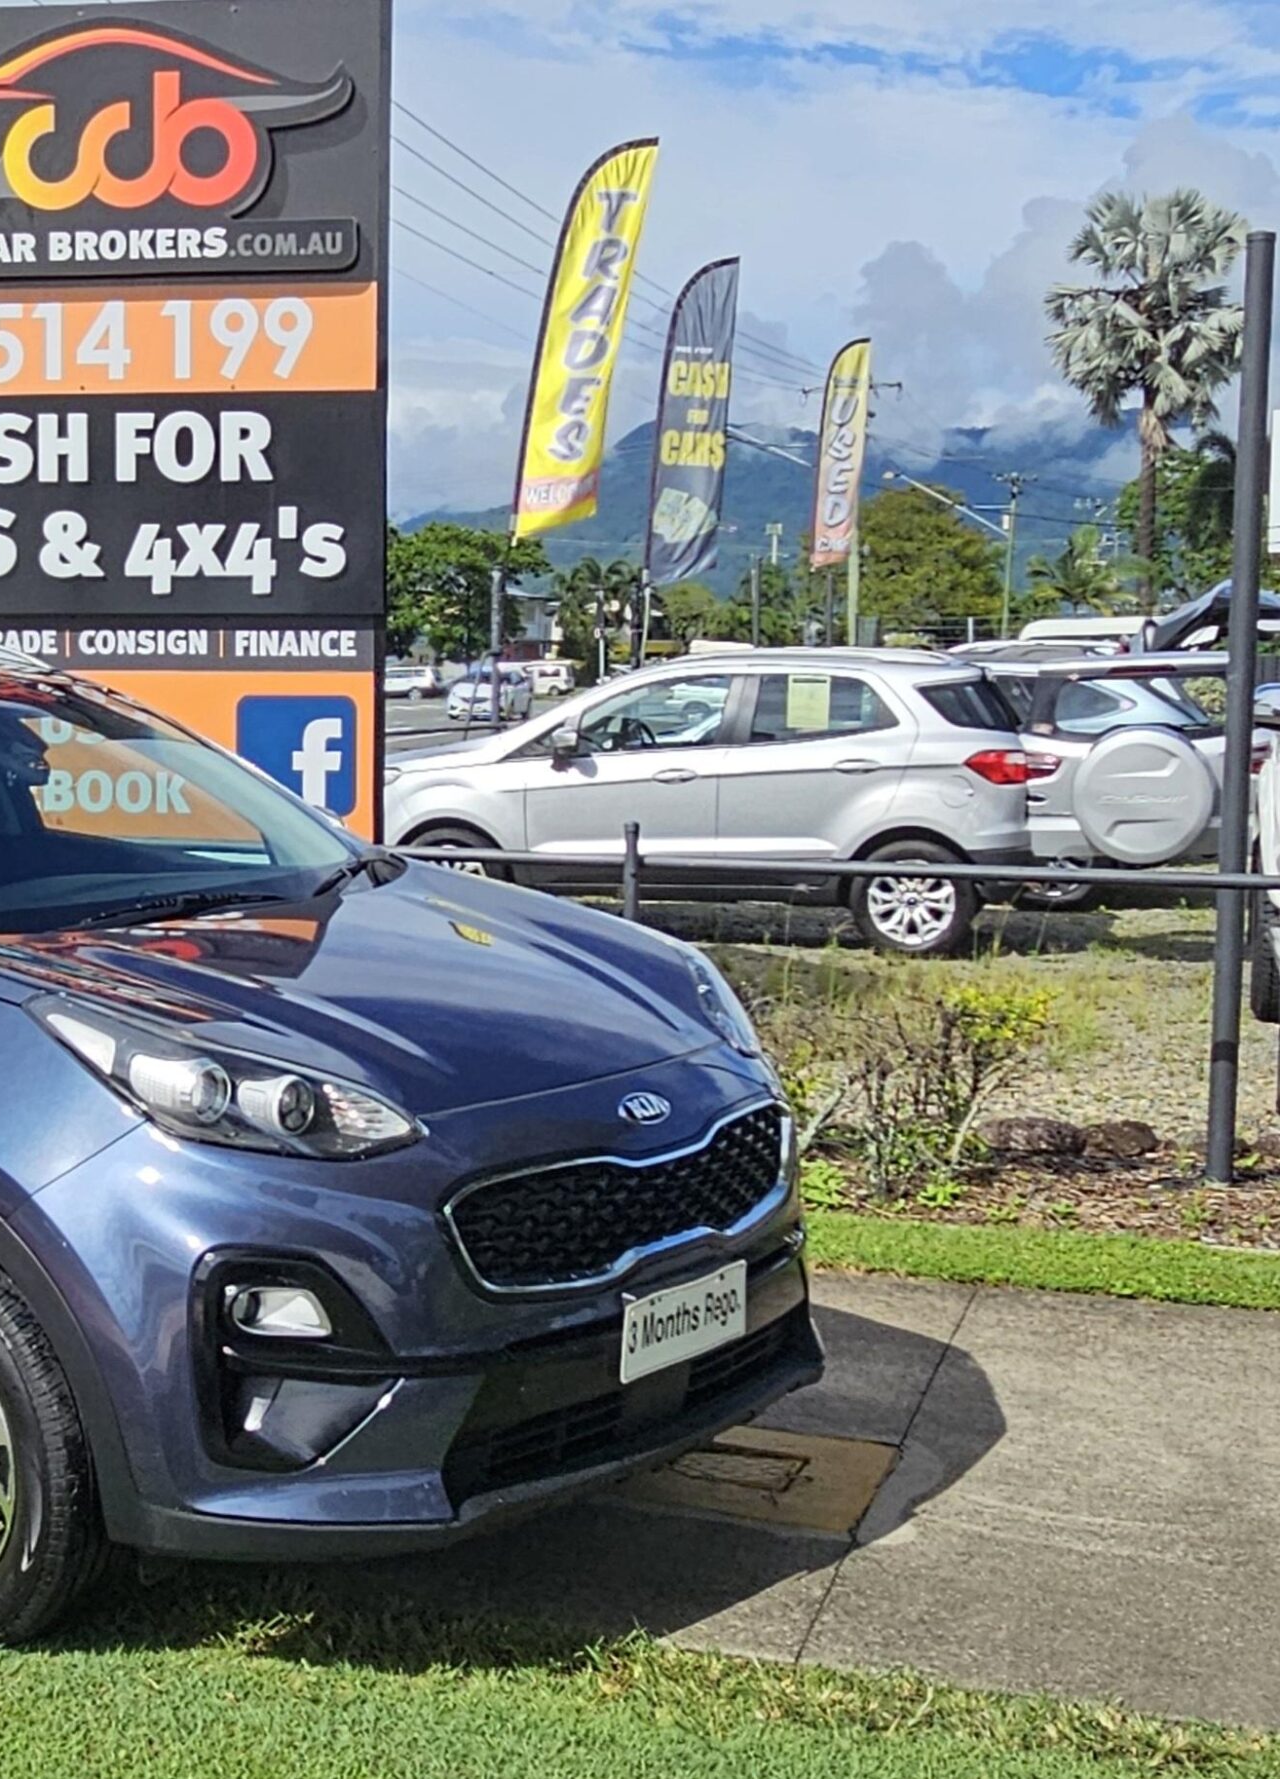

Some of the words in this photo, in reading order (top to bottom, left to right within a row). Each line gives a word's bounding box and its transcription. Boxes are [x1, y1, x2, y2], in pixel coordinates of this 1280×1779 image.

[161, 297, 313, 380] 199
[548, 190, 638, 460] TRADES
[115, 411, 273, 483] FOR
[825, 394, 858, 528] USED
[38, 510, 105, 579] &
[78, 629, 208, 656] CONSIGN
[234, 630, 358, 658] FINANCE
[41, 717, 106, 744] U
[625, 1096, 667, 1119] KIA
[628, 1320, 637, 1354] 3
[642, 1302, 700, 1349] Months
[704, 1288, 741, 1327] Rego.
